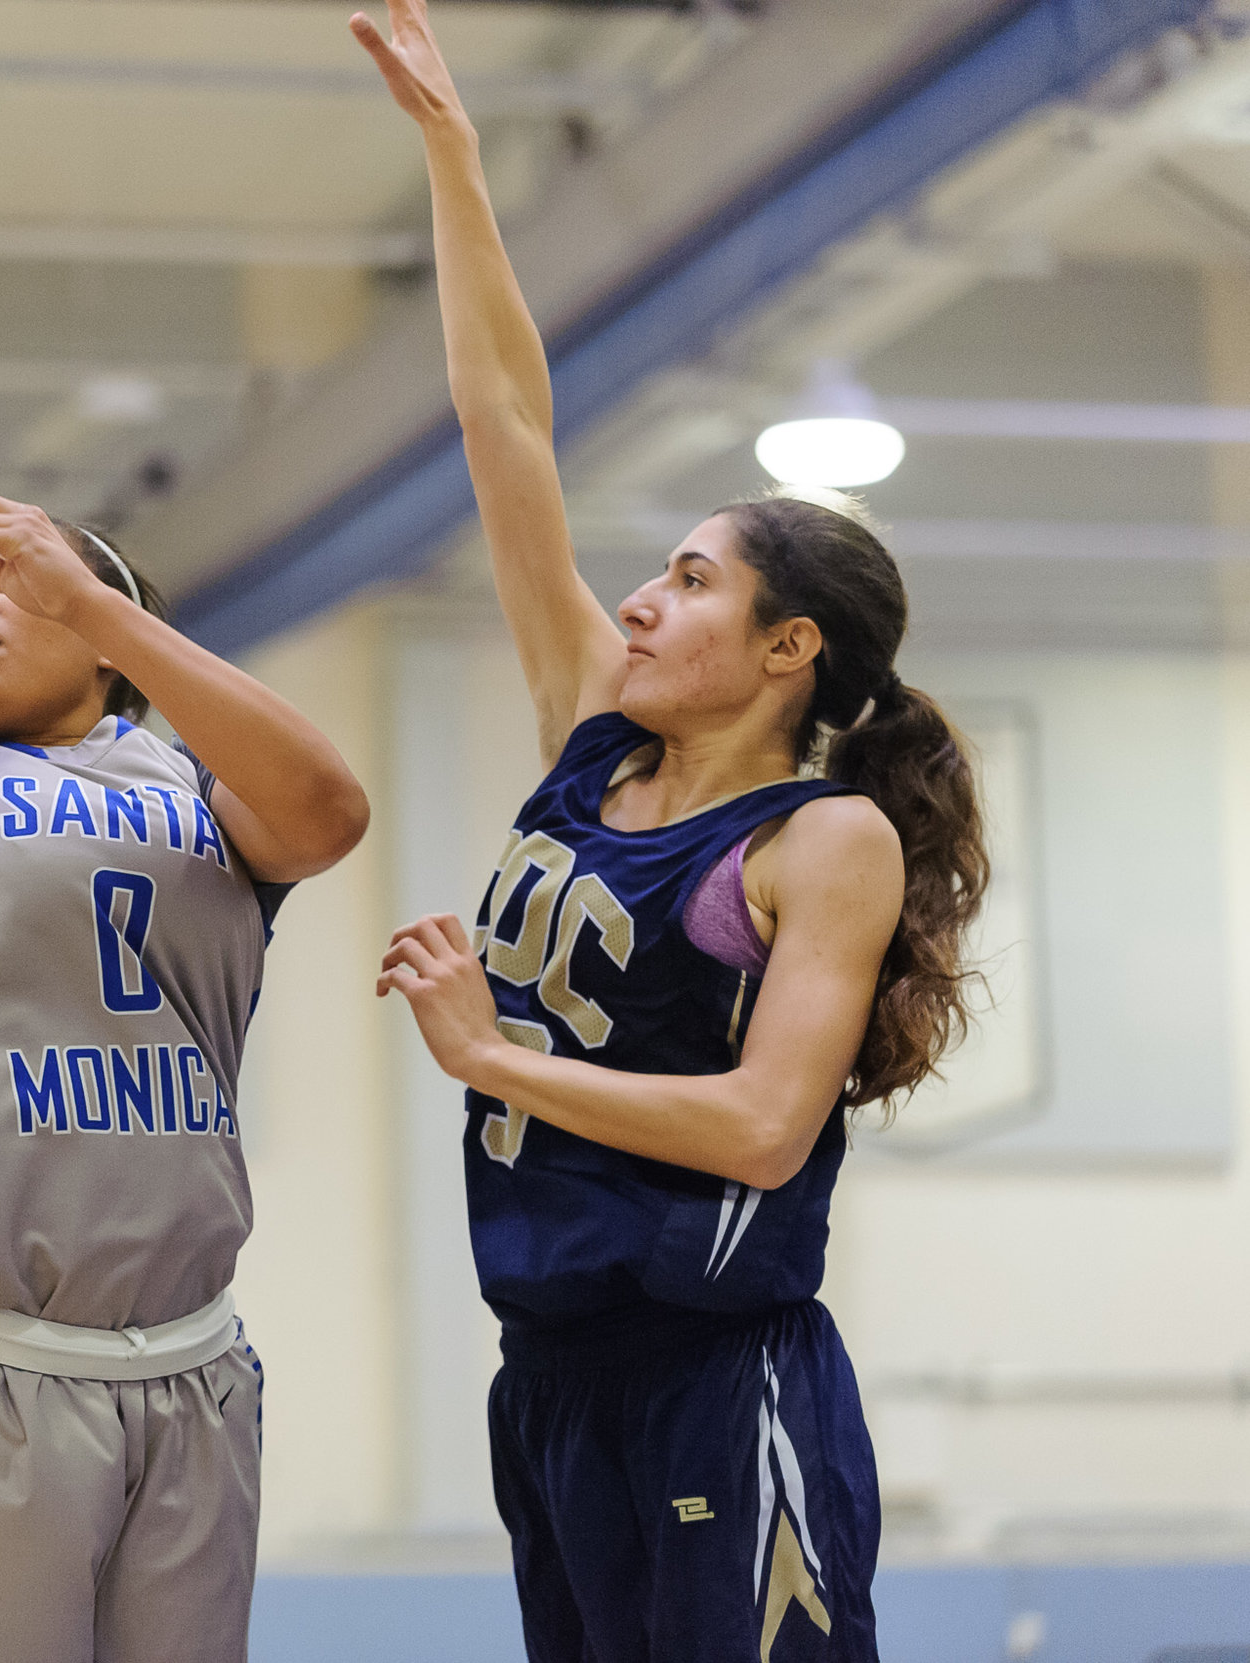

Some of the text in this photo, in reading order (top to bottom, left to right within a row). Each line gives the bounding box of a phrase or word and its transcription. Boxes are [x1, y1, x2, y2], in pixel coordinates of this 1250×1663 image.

[0, 776, 229, 871] SANTA
[91, 866, 164, 1016] 0
[6, 1043, 237, 1137] MONICA
